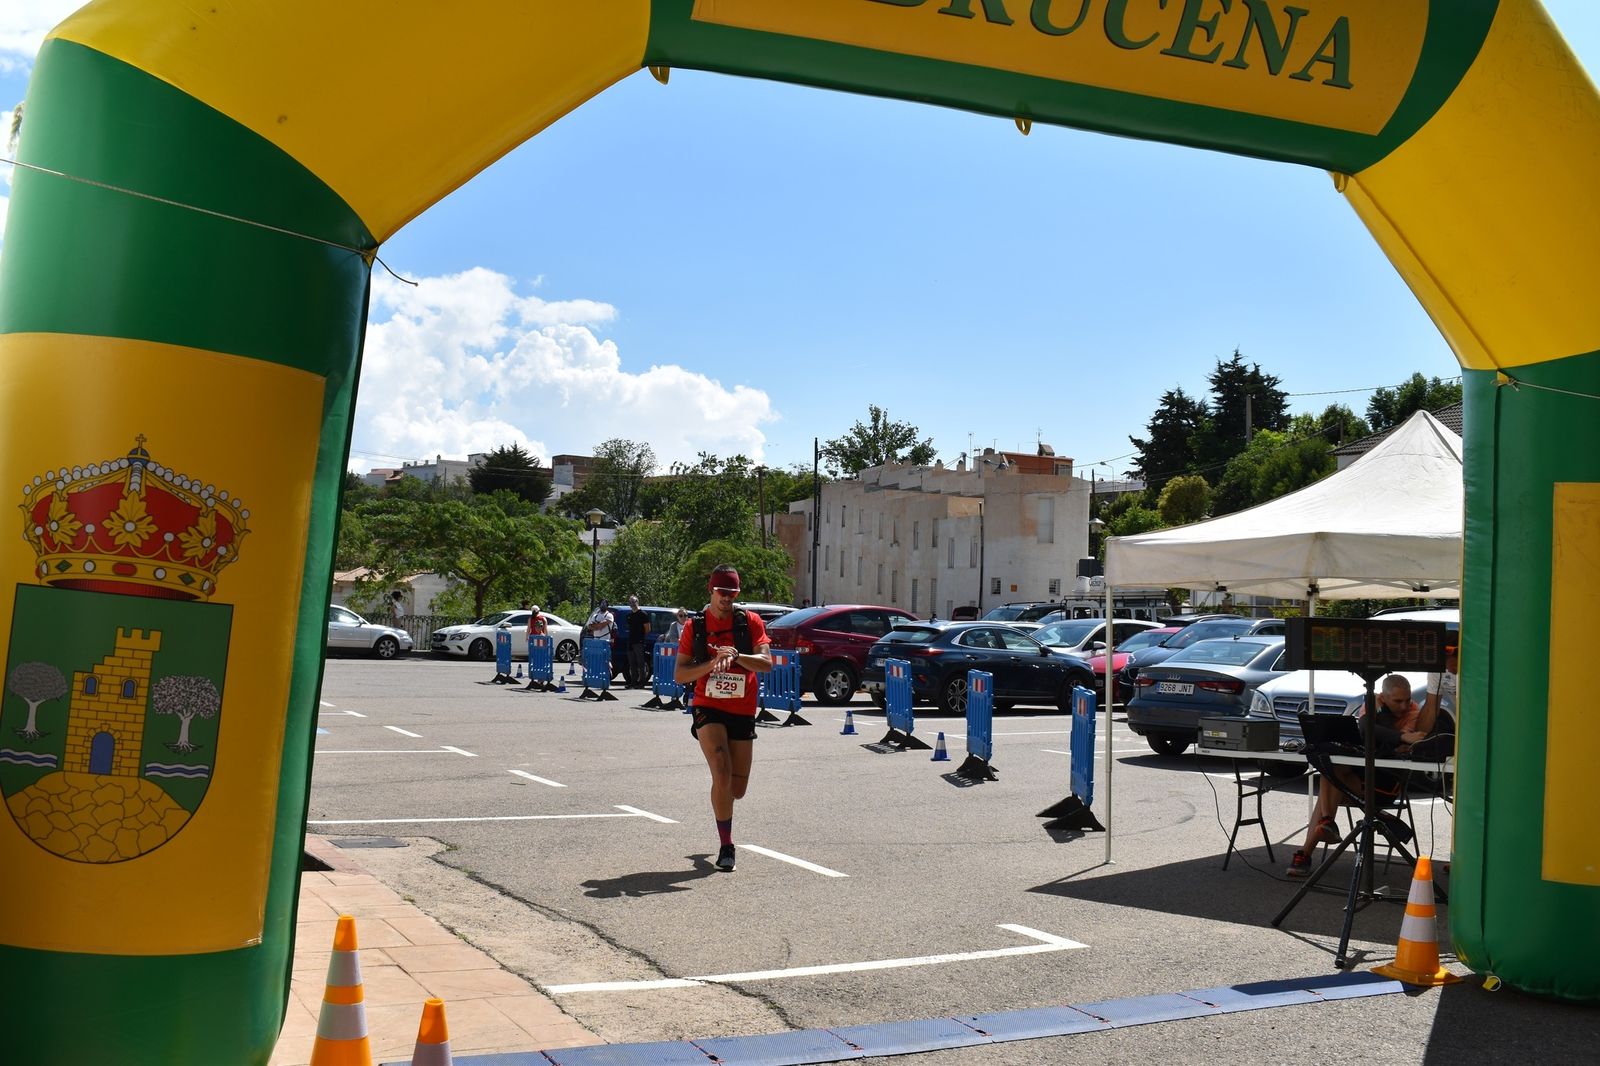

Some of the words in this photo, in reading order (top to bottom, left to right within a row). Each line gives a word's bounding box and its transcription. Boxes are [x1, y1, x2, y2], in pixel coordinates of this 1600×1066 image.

[866, 0, 1354, 90] UCENA
[715, 681, 738, 691] 529
[1160, 683, 1176, 692] 9268
[1179, 684, 1192, 693] JNT
